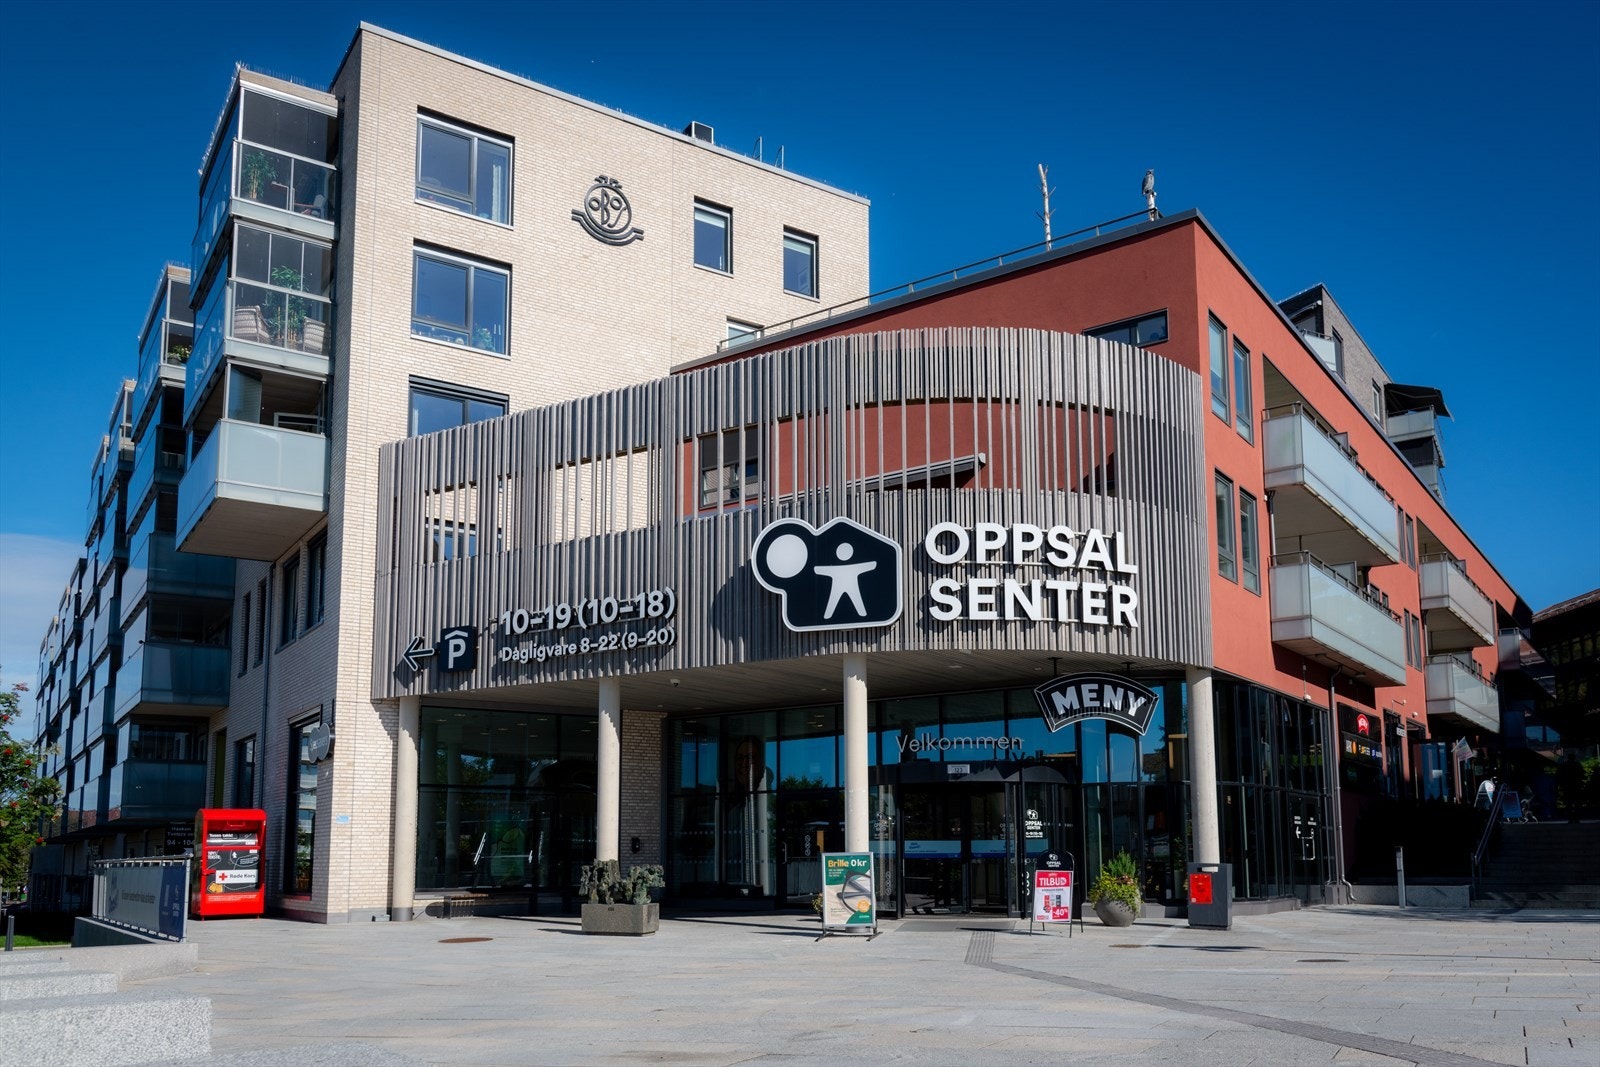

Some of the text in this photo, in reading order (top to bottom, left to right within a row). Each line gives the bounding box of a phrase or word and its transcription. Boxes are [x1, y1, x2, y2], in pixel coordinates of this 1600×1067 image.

[924, 521, 1139, 575] OPPSAL
[500, 586, 677, 636] 10-19 (10-18)
[929, 577, 1139, 628] SENTER
[448, 639, 466, 669] P
[502, 626, 676, 664] Dagligvare 8-22 (9-20)
[1050, 683, 1148, 718] MENY
[895, 733, 1023, 753] Velkommen
[828, 859, 849, 867] Brille
[1038, 877, 1067, 886] TILBUD
